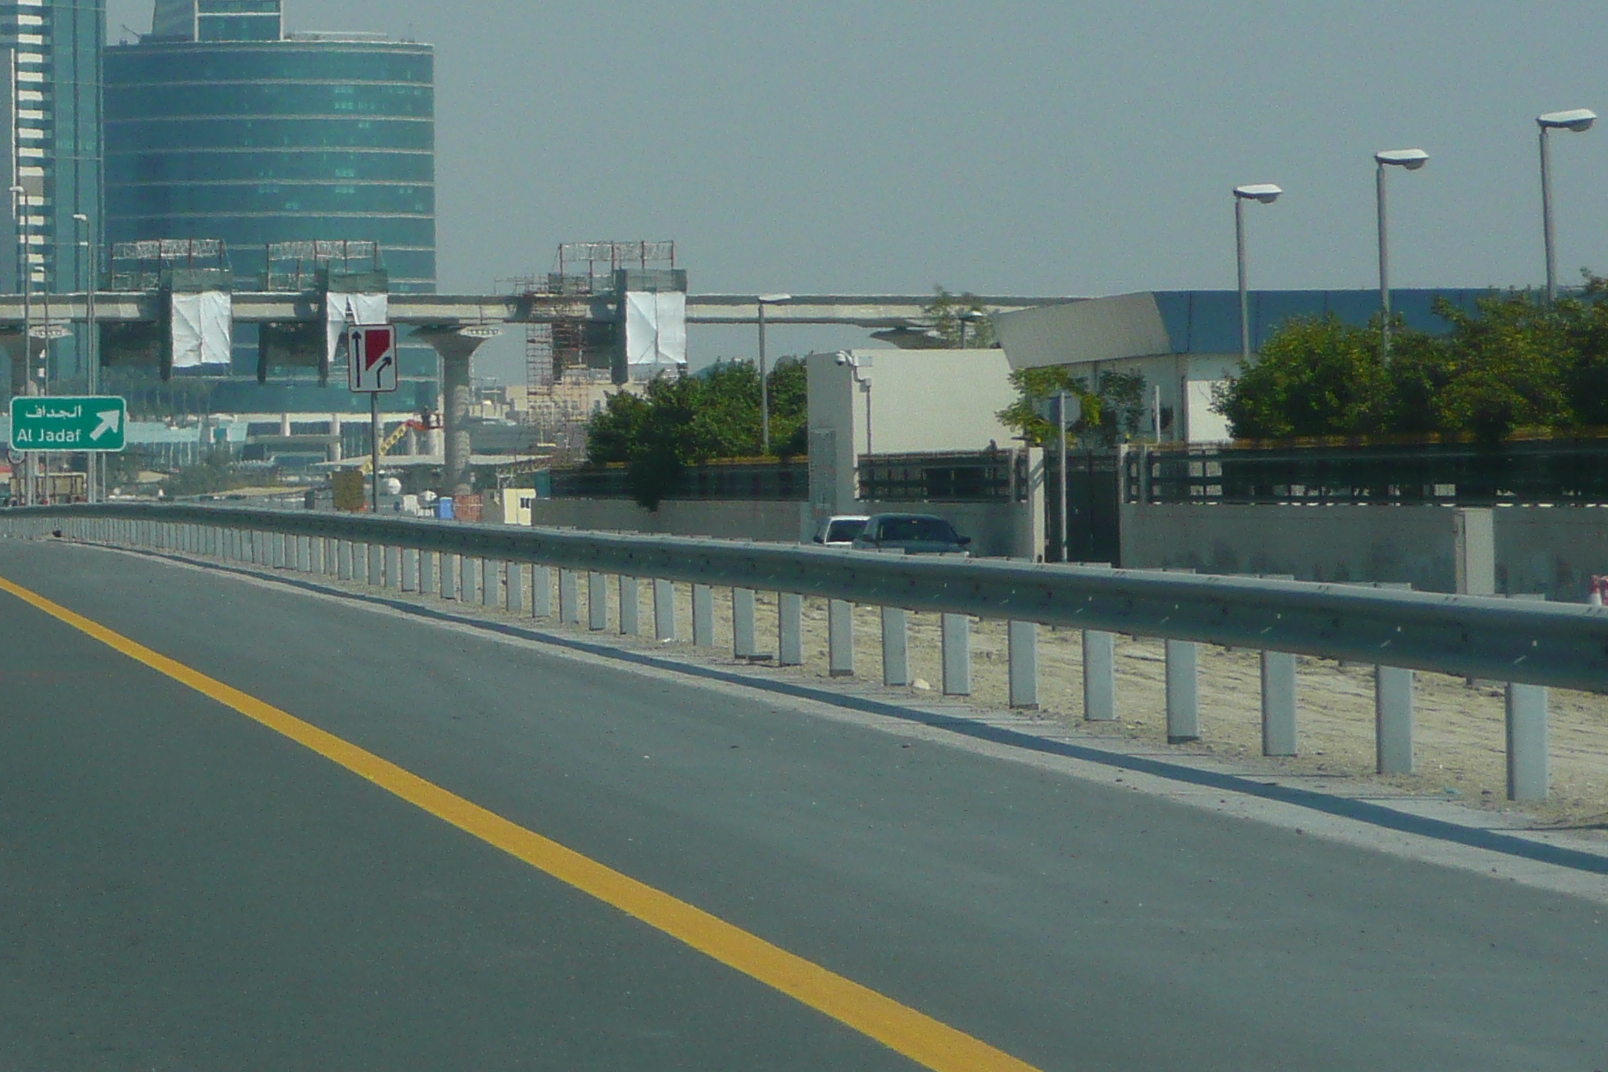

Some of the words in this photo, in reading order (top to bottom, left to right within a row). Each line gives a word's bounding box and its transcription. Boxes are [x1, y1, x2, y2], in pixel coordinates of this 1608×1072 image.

[25, 405, 82, 419] الجداف
[17, 429, 33, 442] Al
[37, 429, 82, 442] Jadaf
